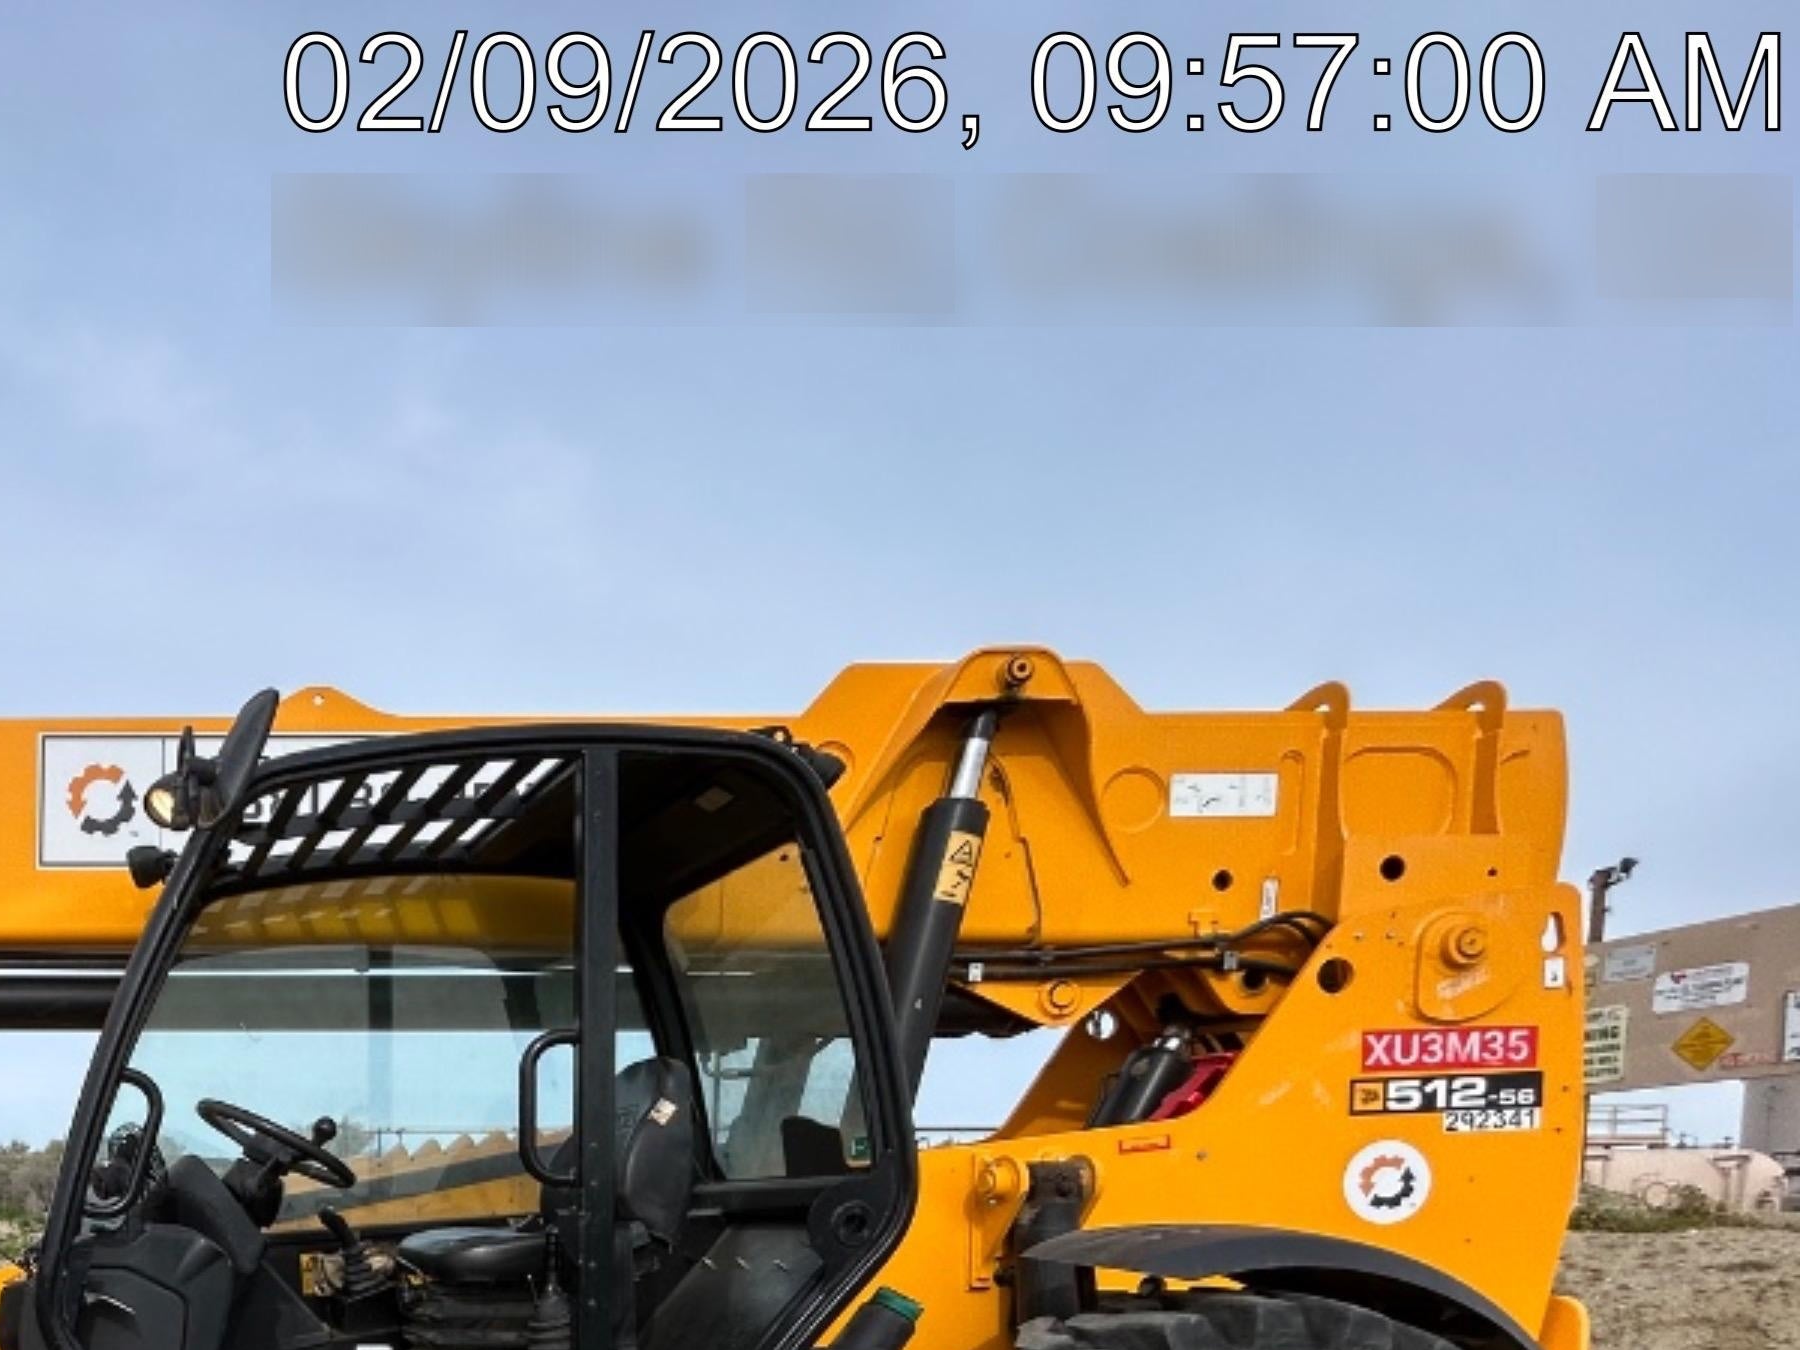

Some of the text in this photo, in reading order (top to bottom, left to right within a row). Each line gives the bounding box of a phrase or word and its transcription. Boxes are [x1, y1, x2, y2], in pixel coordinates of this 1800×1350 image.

[1365, 1030, 1530, 1066] XU3M35
[1385, 1076, 1535, 1110] 512-56
[1445, 1109, 1534, 1131] 292341
